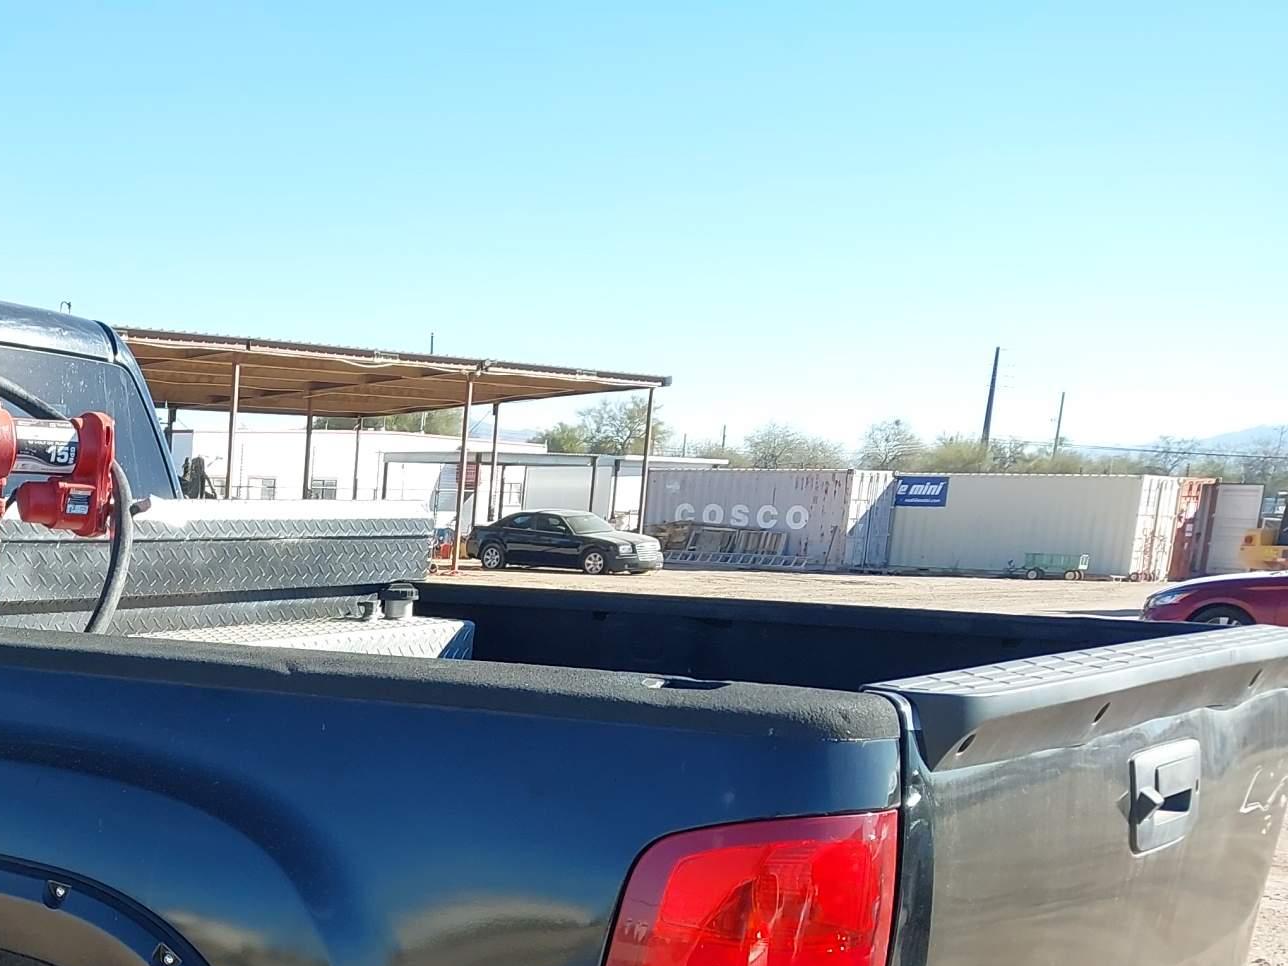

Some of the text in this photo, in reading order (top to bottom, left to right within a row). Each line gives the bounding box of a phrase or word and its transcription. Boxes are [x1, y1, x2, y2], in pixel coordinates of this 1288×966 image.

[46, 446, 69, 463] 15
[908, 481, 946, 495] mini
[675, 503, 809, 530] COSCO
